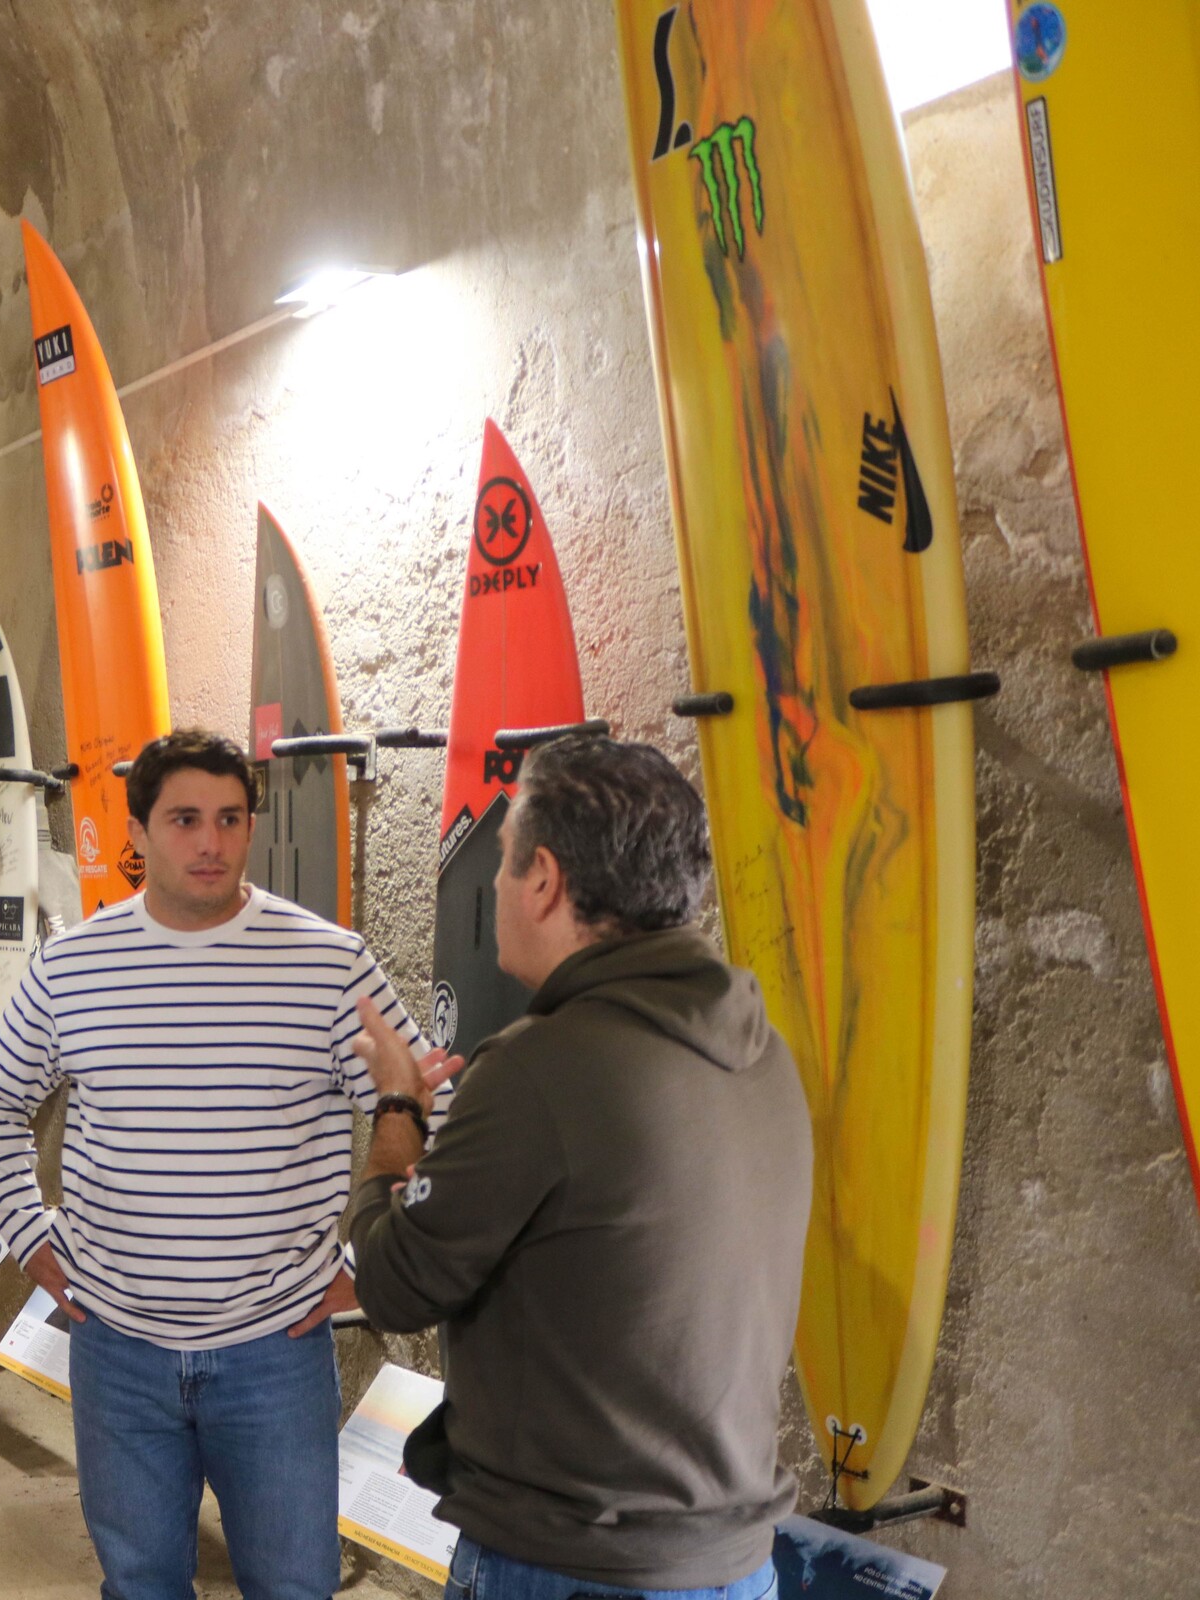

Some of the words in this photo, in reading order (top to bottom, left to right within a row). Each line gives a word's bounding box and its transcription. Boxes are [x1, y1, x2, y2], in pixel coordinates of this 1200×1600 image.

[37, 331, 68, 363] YUKI
[857, 412, 898, 525] NIKE
[438, 815, 473, 865] utures.
